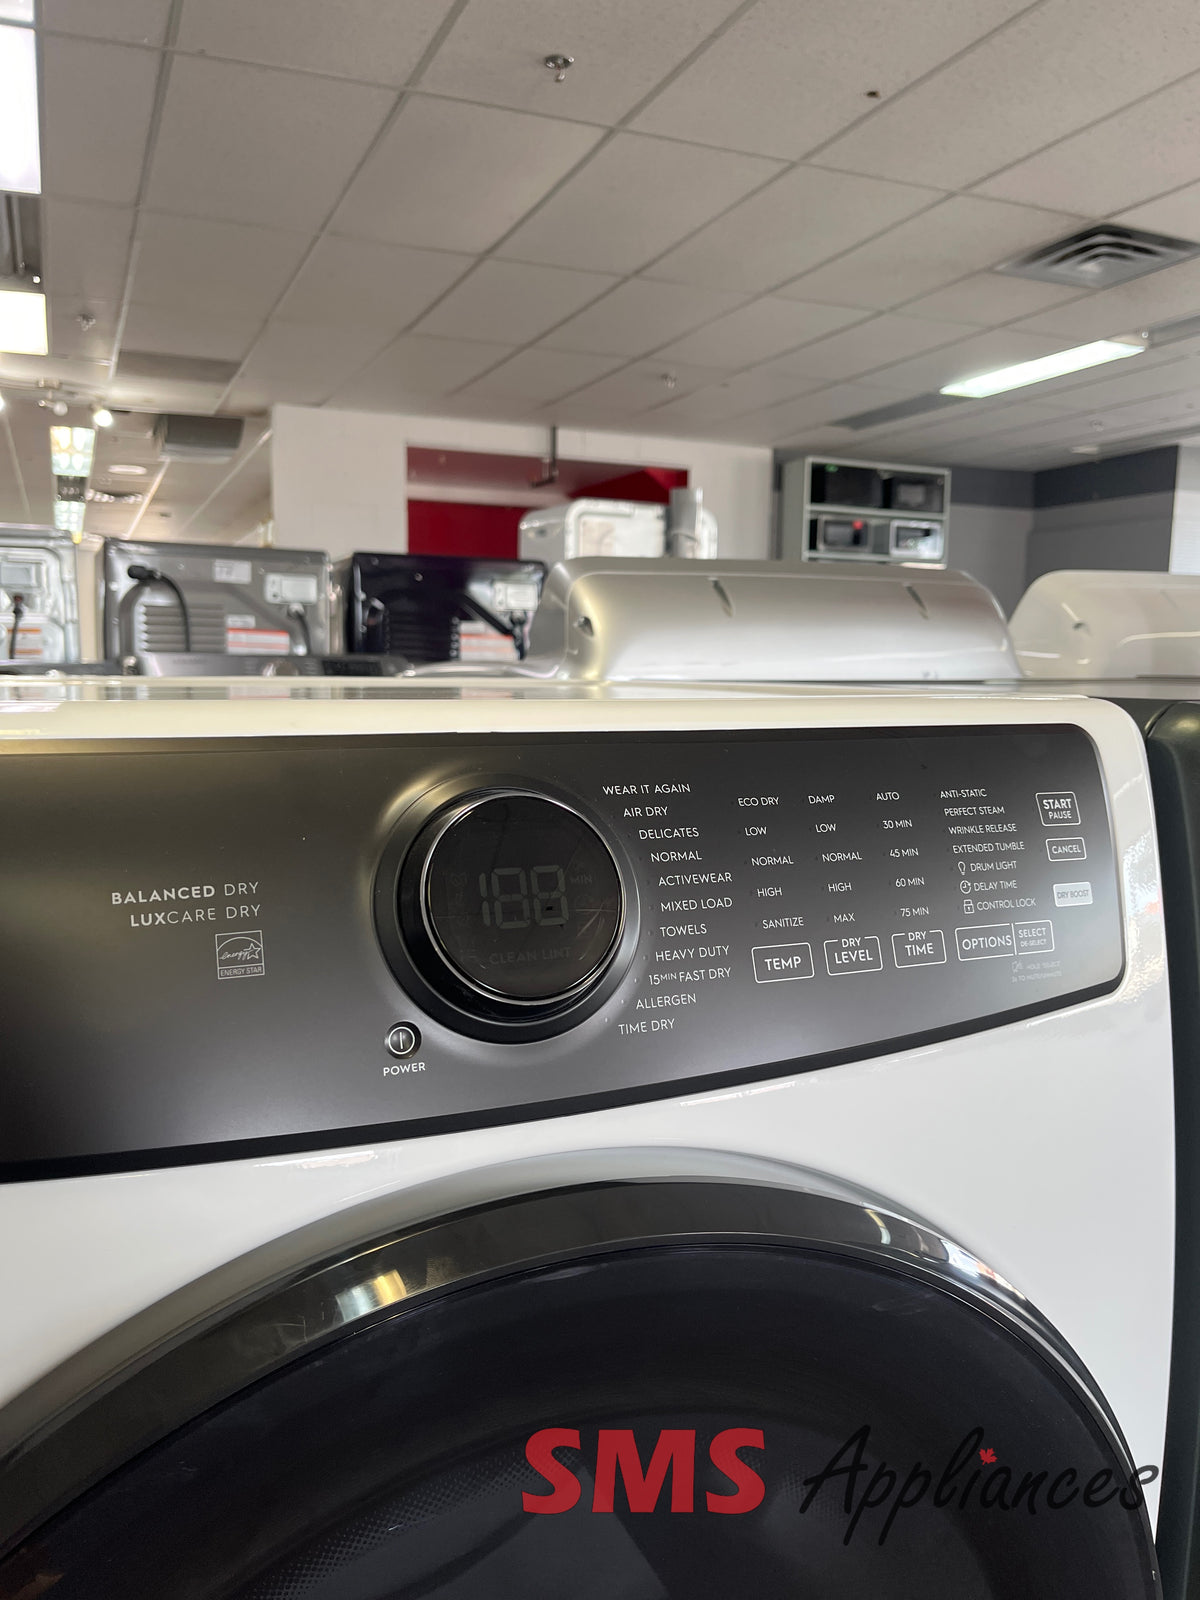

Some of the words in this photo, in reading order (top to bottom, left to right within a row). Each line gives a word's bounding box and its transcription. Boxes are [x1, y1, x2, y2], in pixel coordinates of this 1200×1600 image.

[603, 784, 638, 795] WEAR
[641, 784, 649, 795] IT
[654, 784, 691, 794] AGAIN
[940, 788, 987, 798] ANTI-STATIC
[808, 794, 835, 804] DAMP
[876, 791, 900, 801] AUTO
[738, 797, 759, 807] ECO
[761, 797, 779, 805] DRY
[1043, 799, 1073, 809] START
[623, 807, 643, 817] AIR
[646, 806, 668, 816] DRY
[944, 807, 977, 816] PERFECT
[979, 806, 1005, 815] STEAM
[1048, 810, 1073, 819] PAUSE
[815, 823, 837, 833] LOW
[882, 820, 894, 829] 30
[895, 819, 913, 828] MIN
[948, 825, 984, 835] WRINKLE
[985, 823, 1017, 833] RELEASE
[639, 827, 700, 840] DELICATES
[744, 826, 767, 836] LOW
[889, 848, 901, 858] 45
[902, 847, 919, 857] MIN
[952, 843, 994, 853] EXTENDED
[995, 841, 1025, 851] TUMBLE
[1051, 845, 1082, 854] CANCEL
[650, 850, 703, 863] NORMAL
[751, 855, 795, 867] NORMAL
[822, 852, 863, 863] NORMAL
[970, 862, 994, 872] DRUM
[995, 861, 1017, 870] LIGHT
[570, 874, 593, 885] MIN
[658, 872, 733, 887] ACTIVEWEAR
[895, 878, 907, 888] 60
[907, 877, 925, 886] MIN
[827, 882, 852, 893] HIGH
[974, 882, 998, 892] DELAY
[999, 880, 1018, 890] TIME
[111, 885, 216, 905] BALANCED
[224, 881, 259, 896] DRY
[757, 887, 783, 898] HIGH
[1056, 891, 1069, 900] DRY
[1069, 889, 1090, 898] BOOST
[660, 899, 698, 912] MIXED
[700, 897, 733, 910] LOAD
[976, 900, 1014, 911] CONTROL
[1014, 897, 1037, 908] LOCK
[130, 907, 217, 927] LUXCARE
[226, 904, 261, 919] DRY
[900, 907, 912, 917] 75
[912, 906, 930, 916] MIN
[762, 916, 804, 929] SANITIZE
[833, 912, 856, 923] MAX
[659, 923, 707, 938] TOWELS
[908, 930, 926, 942] DRY
[1018, 927, 1046, 938] SELECT
[841, 936, 861, 949] DRY
[961, 934, 1012, 951] OPTIONS
[655, 948, 695, 962] HEAVY
[699, 945, 730, 958] DUTY
[904, 942, 934, 957] TIME
[489, 950, 537, 965] CLEAN
[834, 949, 873, 964] LEVEL
[764, 956, 802, 971] TEMP
[220, 968, 246, 977] ENERGY
[246, 966, 263, 974] STAR
[679, 969, 705, 982] FAST
[708, 967, 732, 980] DRY
[635, 993, 697, 1010] ALLERGEN
[618, 1022, 648, 1035] TIME
[651, 1018, 675, 1032] DRY
[383, 1062, 426, 1077] POWER
